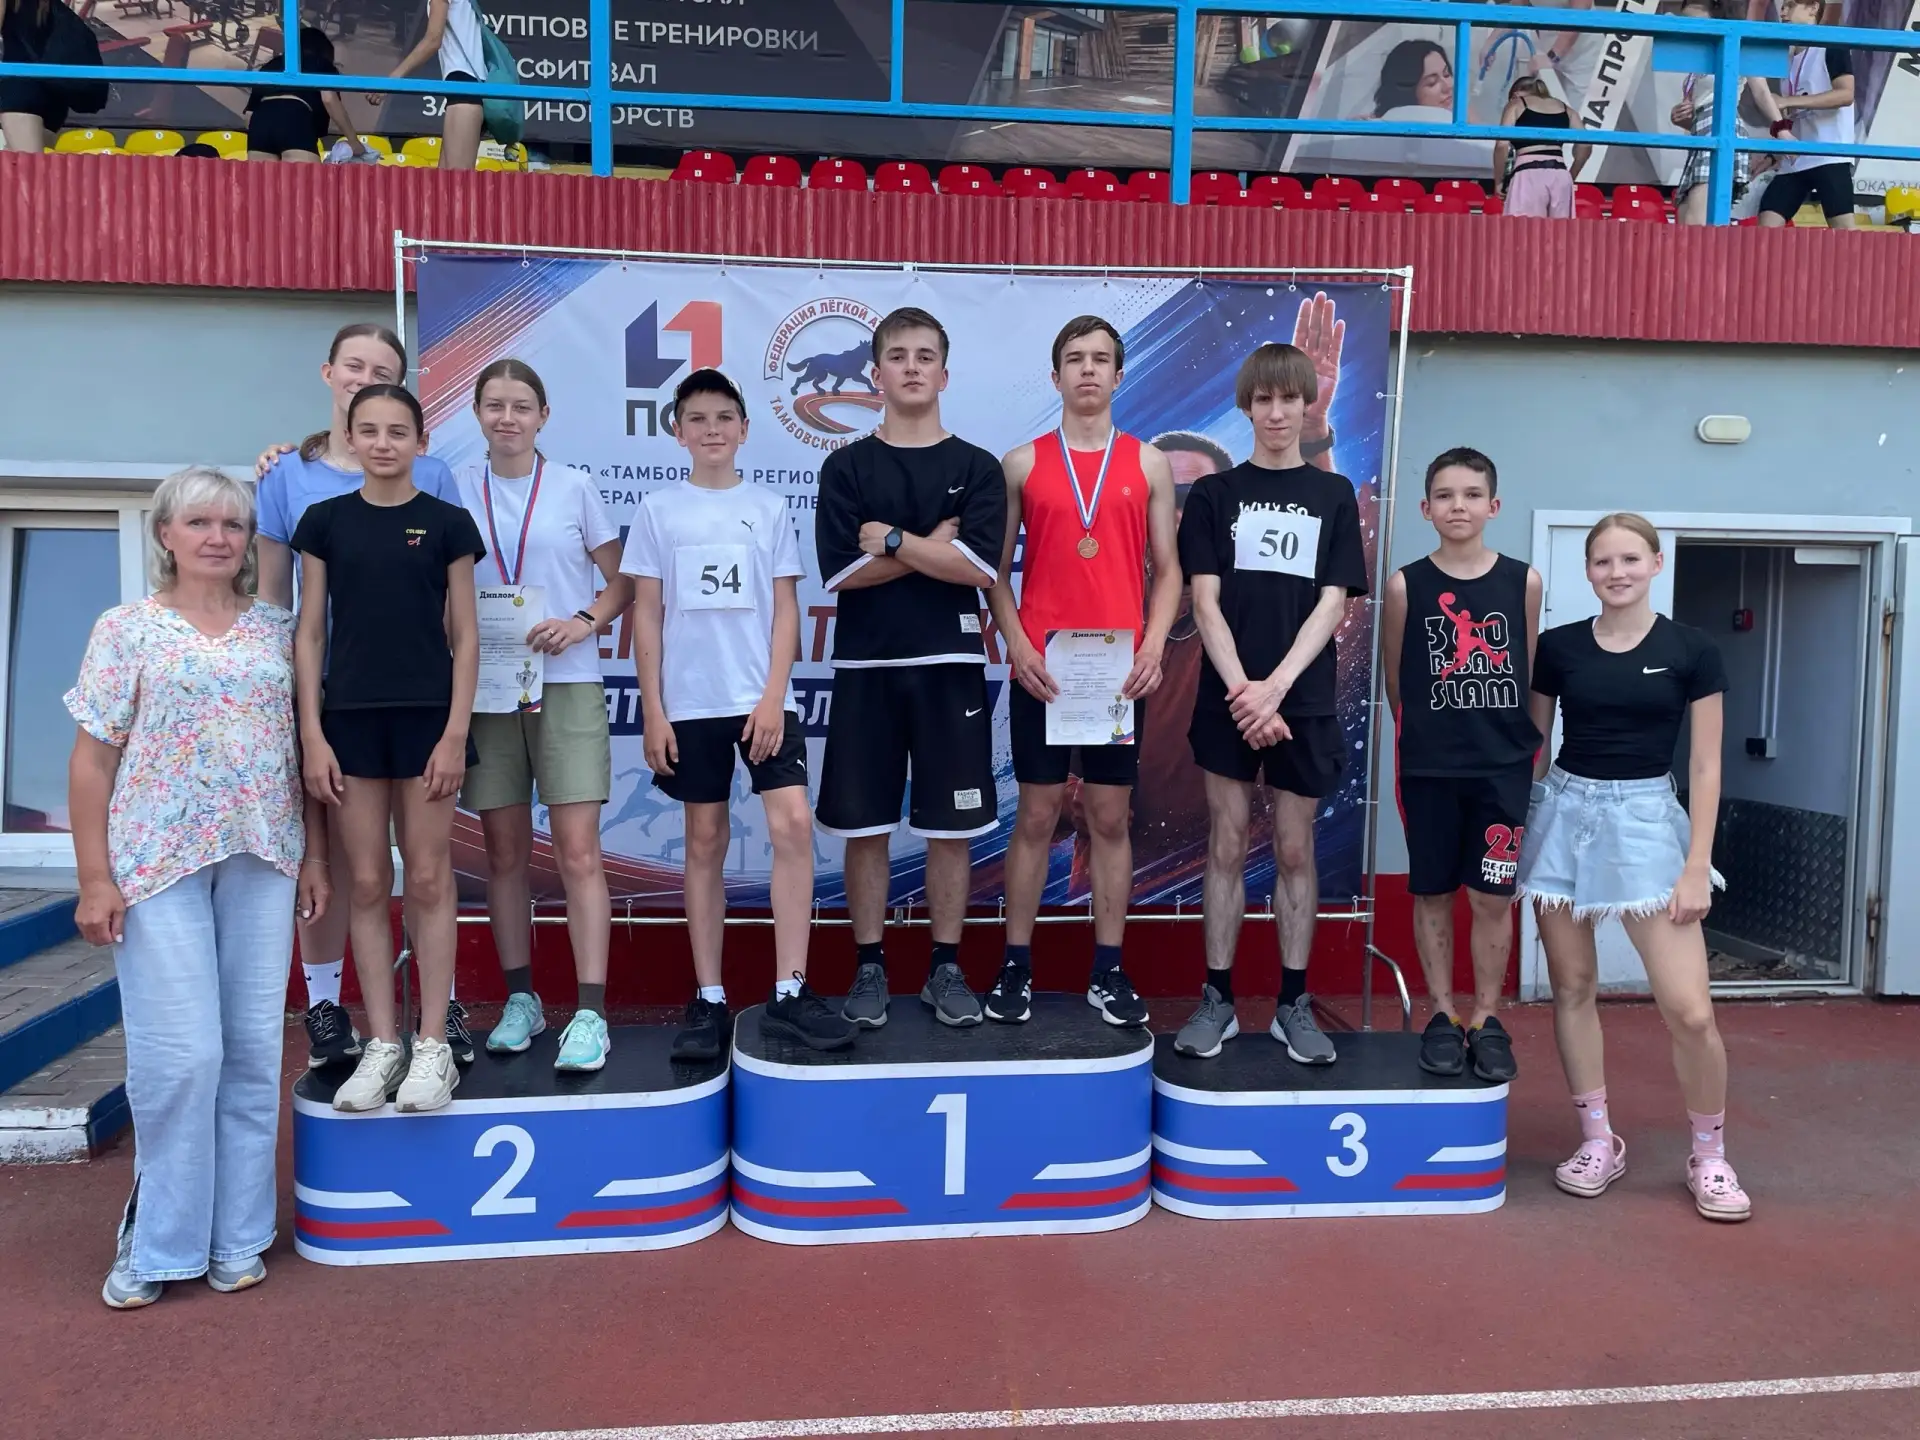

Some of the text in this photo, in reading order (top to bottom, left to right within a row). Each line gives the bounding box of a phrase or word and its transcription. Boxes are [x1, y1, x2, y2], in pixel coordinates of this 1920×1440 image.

[634, 21, 819, 51] ТРЕНИРОВКИ
[516, 57, 592, 82] СФИТ
[422, 95, 448, 117] ЗА
[768, 299, 869, 372] ФЕДЕРАЦИЯ ЛЁГКОЙ
[1258, 529, 1299, 561] 50
[479, 591, 515, 599] Диплом
[700, 563, 742, 595] 54
[1430, 678, 1519, 710] SLAM
[925, 1093, 967, 1196] 1
[1325, 1111, 1369, 1178] 3
[471, 1124, 537, 1216] 2
